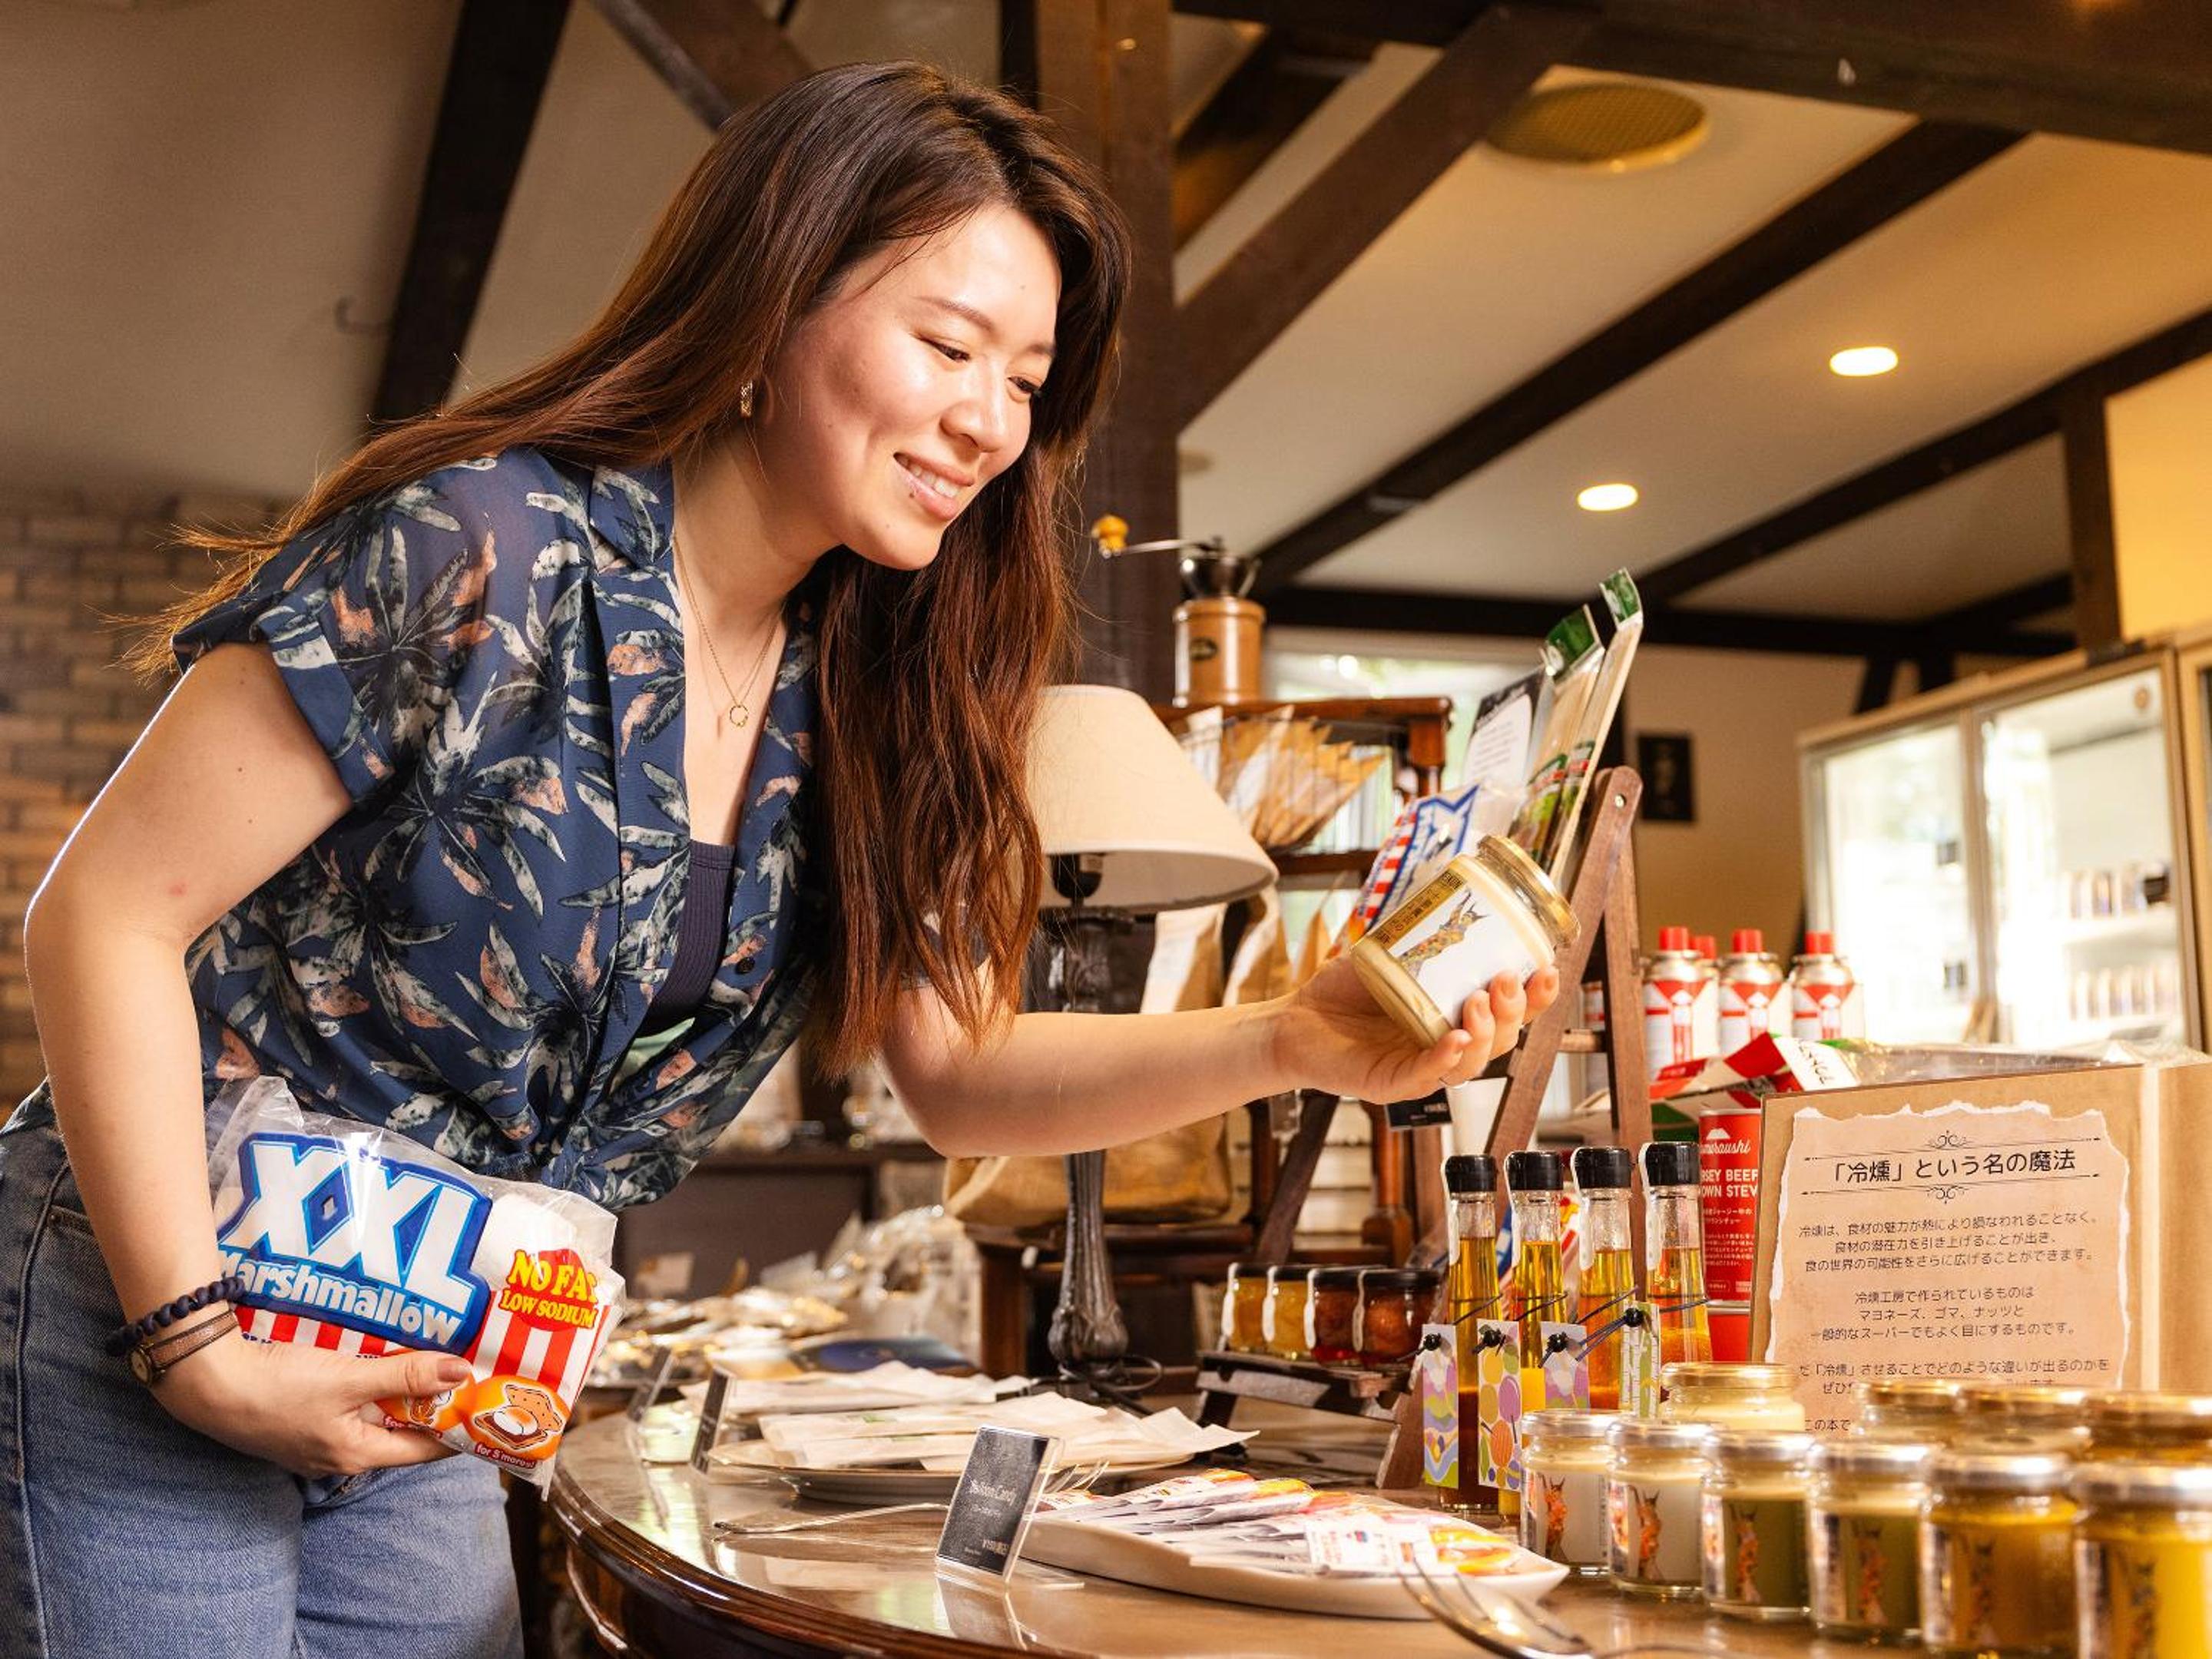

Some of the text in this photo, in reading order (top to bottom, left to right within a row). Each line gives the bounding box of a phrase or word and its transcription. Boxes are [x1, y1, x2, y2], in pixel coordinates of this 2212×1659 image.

[1835, 1149, 2075, 1183] 「冷燻」という名の魔法
[1699, 1184, 1722, 1198] OWN
[221, 1142, 476, 1314] XXL
[507, 1249, 553, 1292] NO
[499, 1289, 598, 1328] LOW SODIUM
[1799, 1359, 2110, 1377] だ「冷燻」させることでどのような違いが出るのかを
[475, 1443, 492, 1457] for
